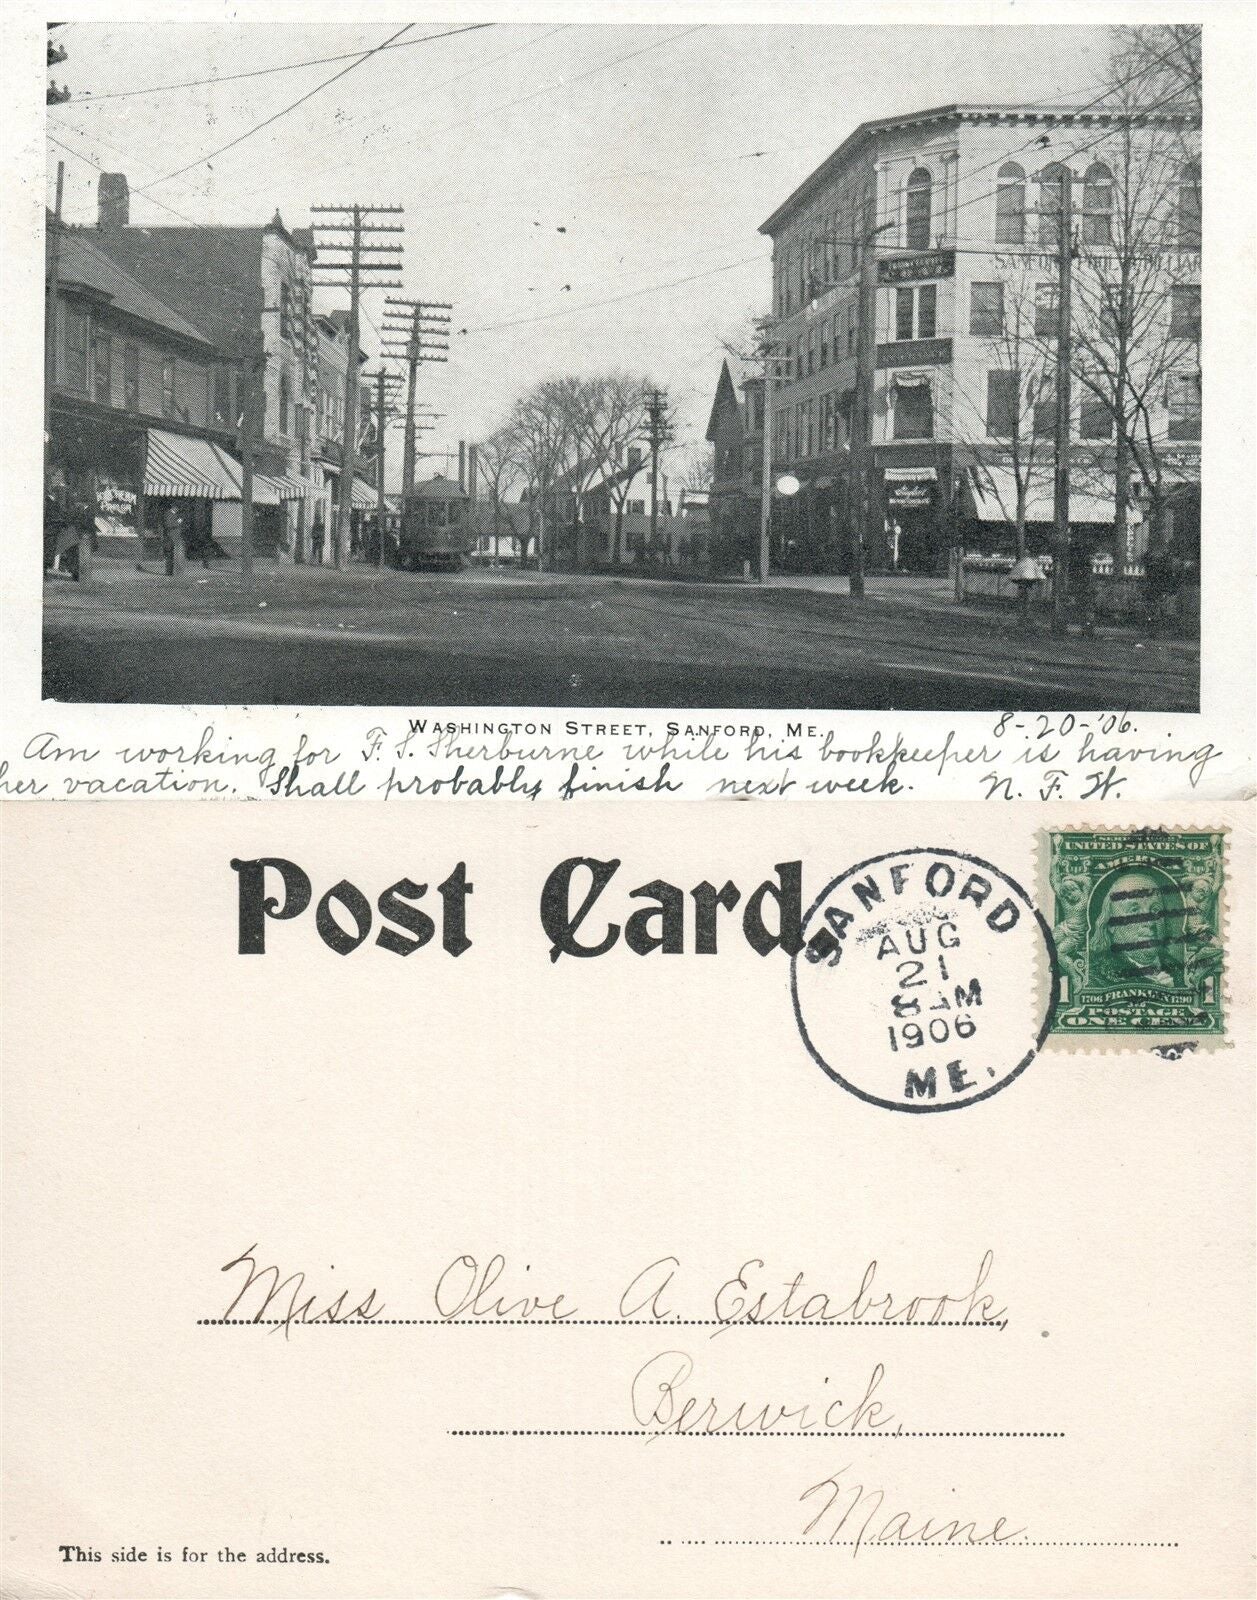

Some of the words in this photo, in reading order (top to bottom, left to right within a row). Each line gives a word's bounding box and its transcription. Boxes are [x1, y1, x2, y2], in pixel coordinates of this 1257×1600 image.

[409, 719, 550, 735] WASHINGTON
[565, 721, 652, 738] STREET,
[666, 722, 772, 738] SANFORD,
[786, 723, 824, 738] ME.
[23, 732, 100, 761] Am
[115, 725, 277, 788] working
[295, 733, 341, 765] for
[622, 731, 729, 762] while
[744, 729, 803, 762] his
[819, 730, 1001, 777] bookkeeper
[1012, 736, 1060, 763] is
[1077, 732, 1223, 789] having
[0, 760, 48, 794] her
[63, 766, 237, 795] vacation.
[266, 759, 366, 797] Shall
[377, 764, 543, 801] probably
[558, 762, 684, 801] finish
[706, 767, 797, 795] next
[805, 760, 914, 794] week.
[1064, 841, 1123, 851] UNITED
[1124, 841, 1186, 851] STATES
[1187, 841, 1209, 851] OF
[230, 857, 474, 957] Post
[540, 857, 807, 964] Card
[805, 862, 1020, 967] SANFORD
[876, 921, 961, 961] AUG
[895, 954, 950, 989] 21
[1058, 975, 1070, 1003] 1
[1203, 975, 1215, 1004] 1
[890, 994, 922, 1018] 8
[1081, 995, 1103, 1004] 1706
[1087, 1007, 1185, 1017] POSTAGE
[888, 1013, 977, 1052] 1906
[1066, 1016, 1127, 1027] ONE
[904, 1059, 996, 1099] ME.
[220, 1242, 386, 1341] Miss
[434, 1253, 579, 1323] Olive
[619, 1255, 681, 1320] A.
[709, 1249, 1009, 1340] Estabrook,
[631, 1350, 903, 1446] Berwick,
[799, 1462, 1029, 1560] Maine.
[58, 1545, 102, 1563] This
[111, 1546, 148, 1563] side
[157, 1546, 172, 1563] is
[182, 1546, 208, 1563] for
[217, 1546, 247, 1563] the
[256, 1546, 331, 1564] address.
